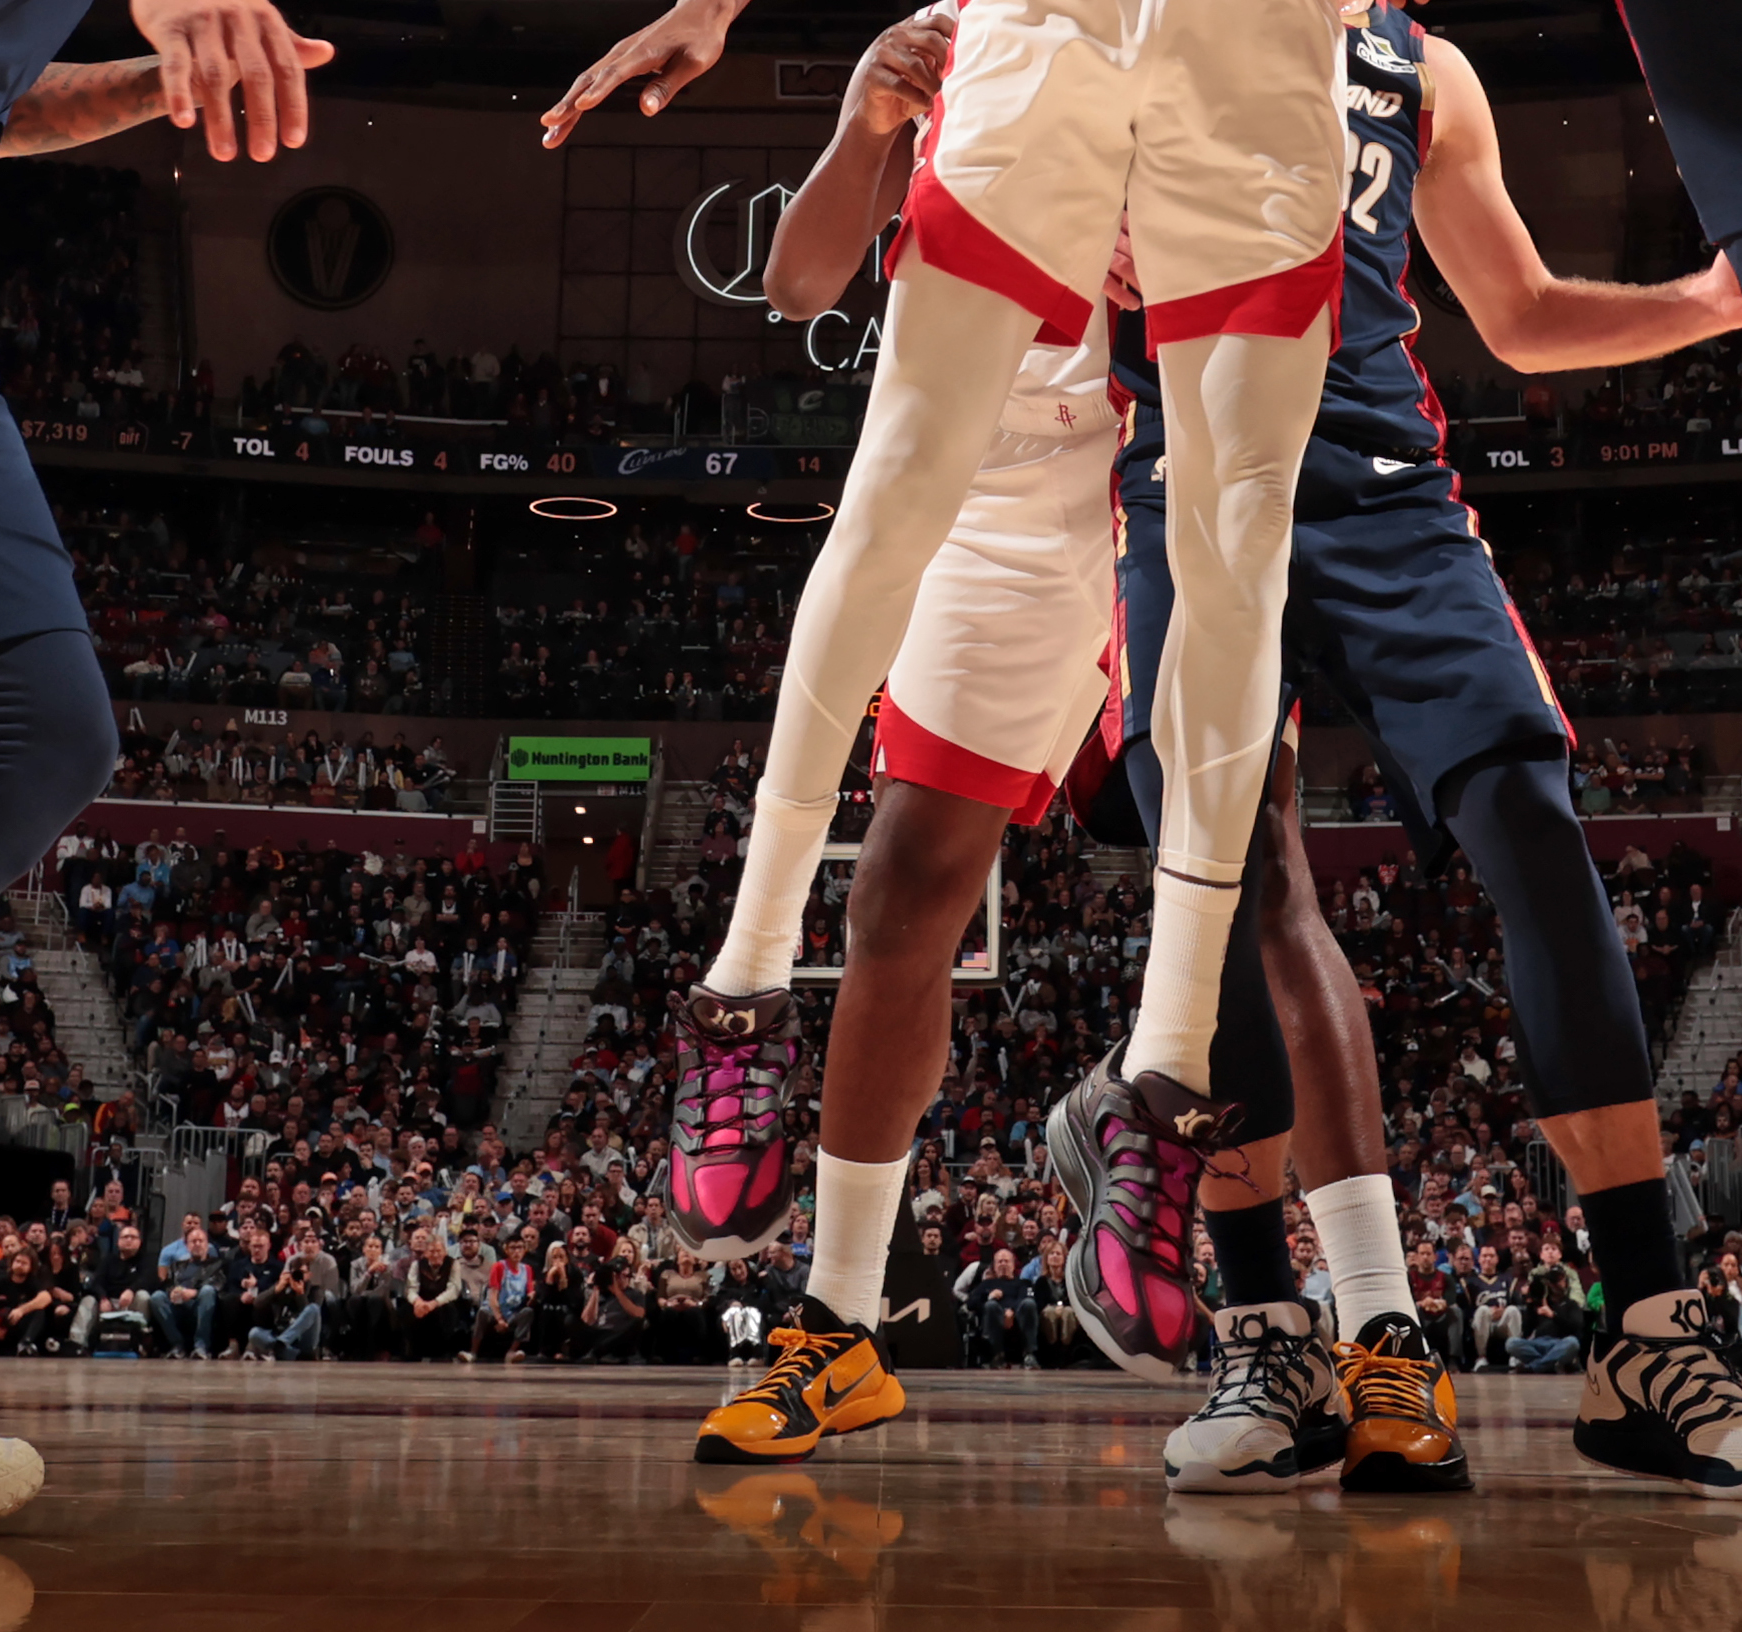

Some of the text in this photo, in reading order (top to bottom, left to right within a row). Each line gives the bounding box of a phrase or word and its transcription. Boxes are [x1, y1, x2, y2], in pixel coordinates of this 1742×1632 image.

[21, 419, 89, 443] $7,319
[233, 437, 310, 462] TOL 4
[344, 445, 449, 471] FOULS 4
[1486, 446, 1565, 468] TOL 3
[1600, 442, 1679, 462] 9:01 PM
[479, 452, 576, 474] FG% 40
[705, 452, 738, 476] 67
[797, 456, 822, 474] 14
[244, 709, 288, 726] M113
[532, 750, 649, 768] Huntington Bank
